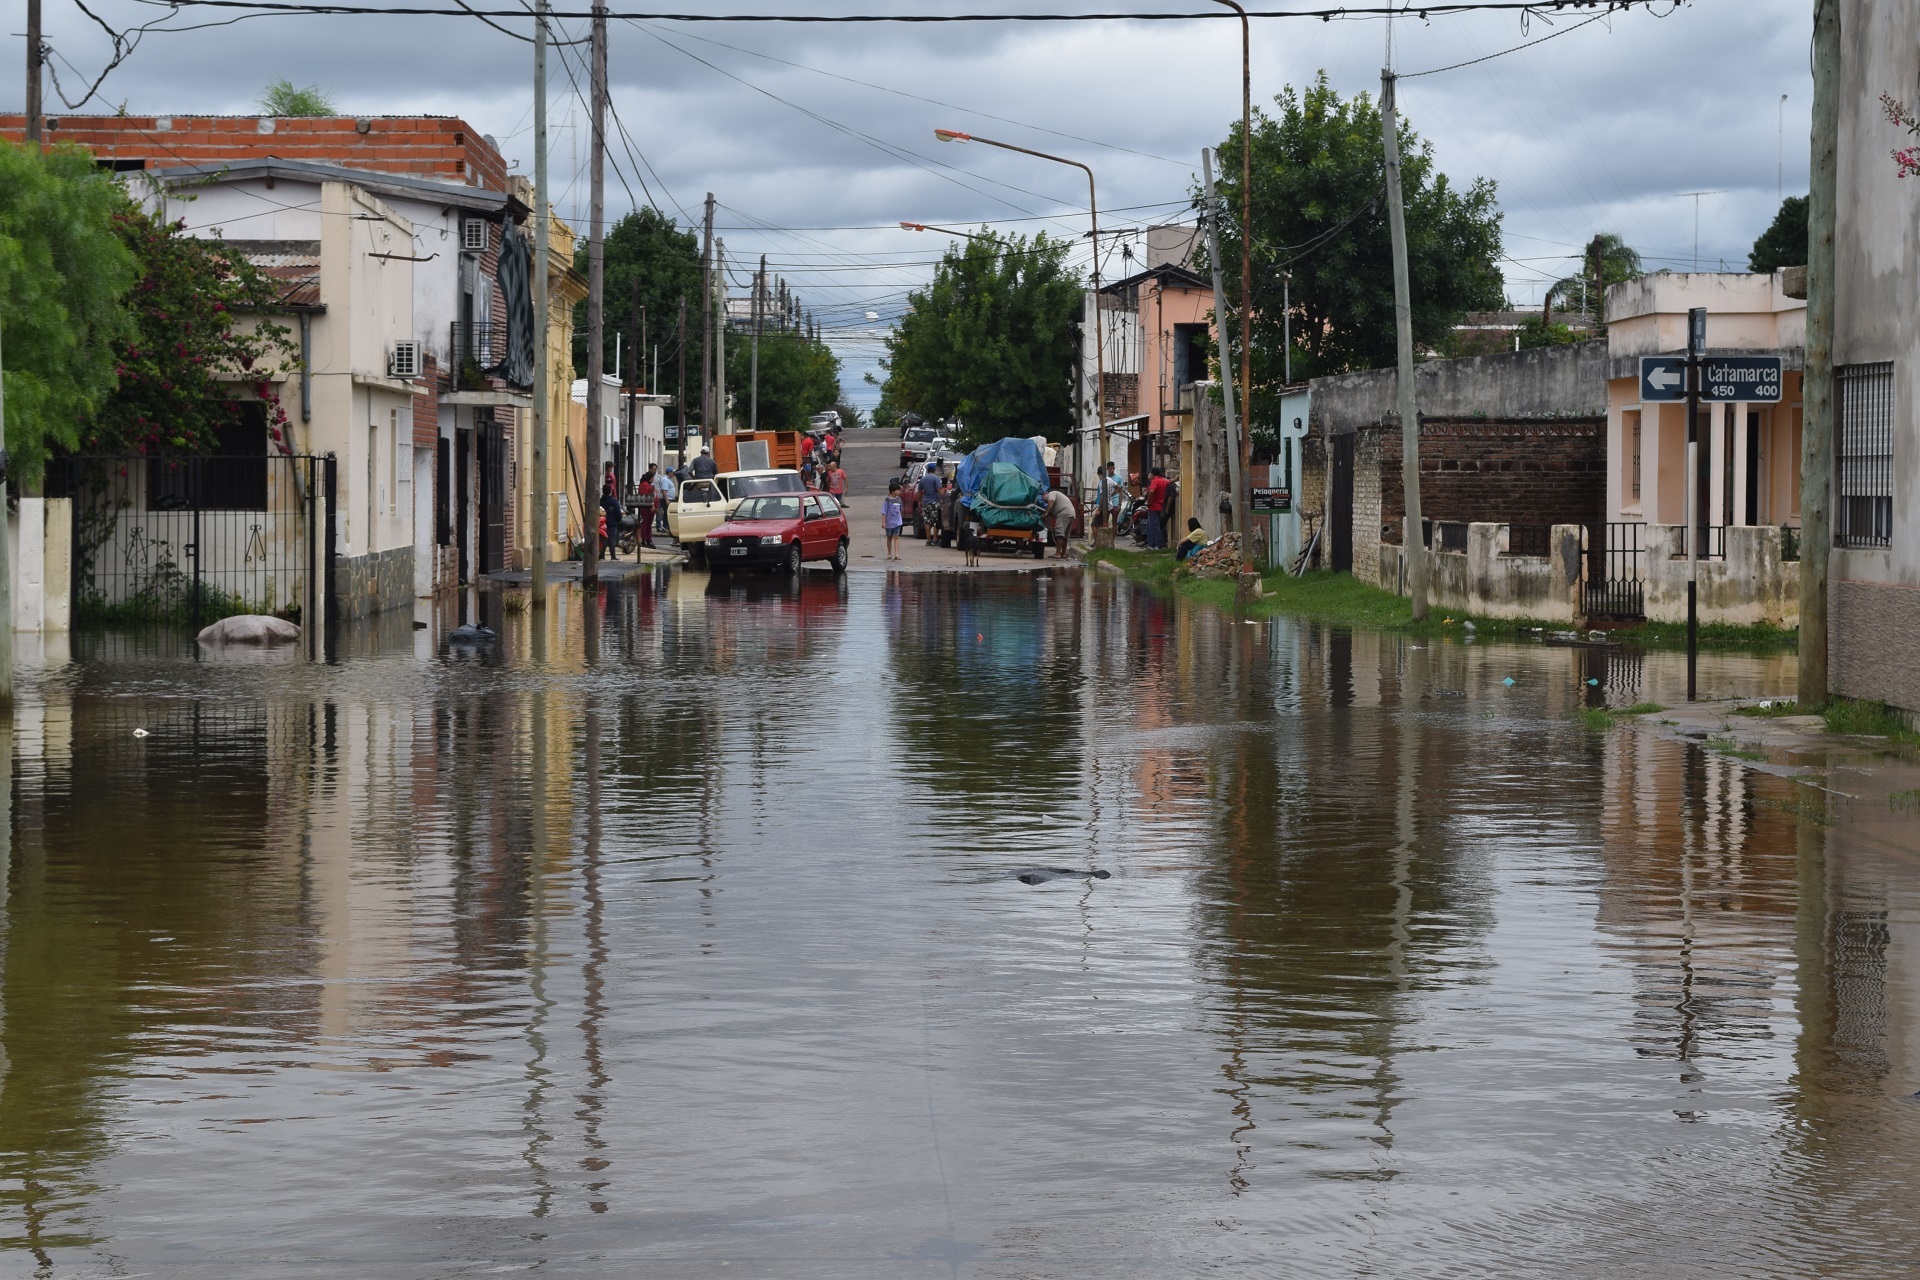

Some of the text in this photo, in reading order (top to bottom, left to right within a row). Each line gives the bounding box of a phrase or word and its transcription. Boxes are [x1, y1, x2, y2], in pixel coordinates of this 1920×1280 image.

[1707, 363, 1778, 382] Catamarca
[1711, 385, 1778, 397] 450 400
